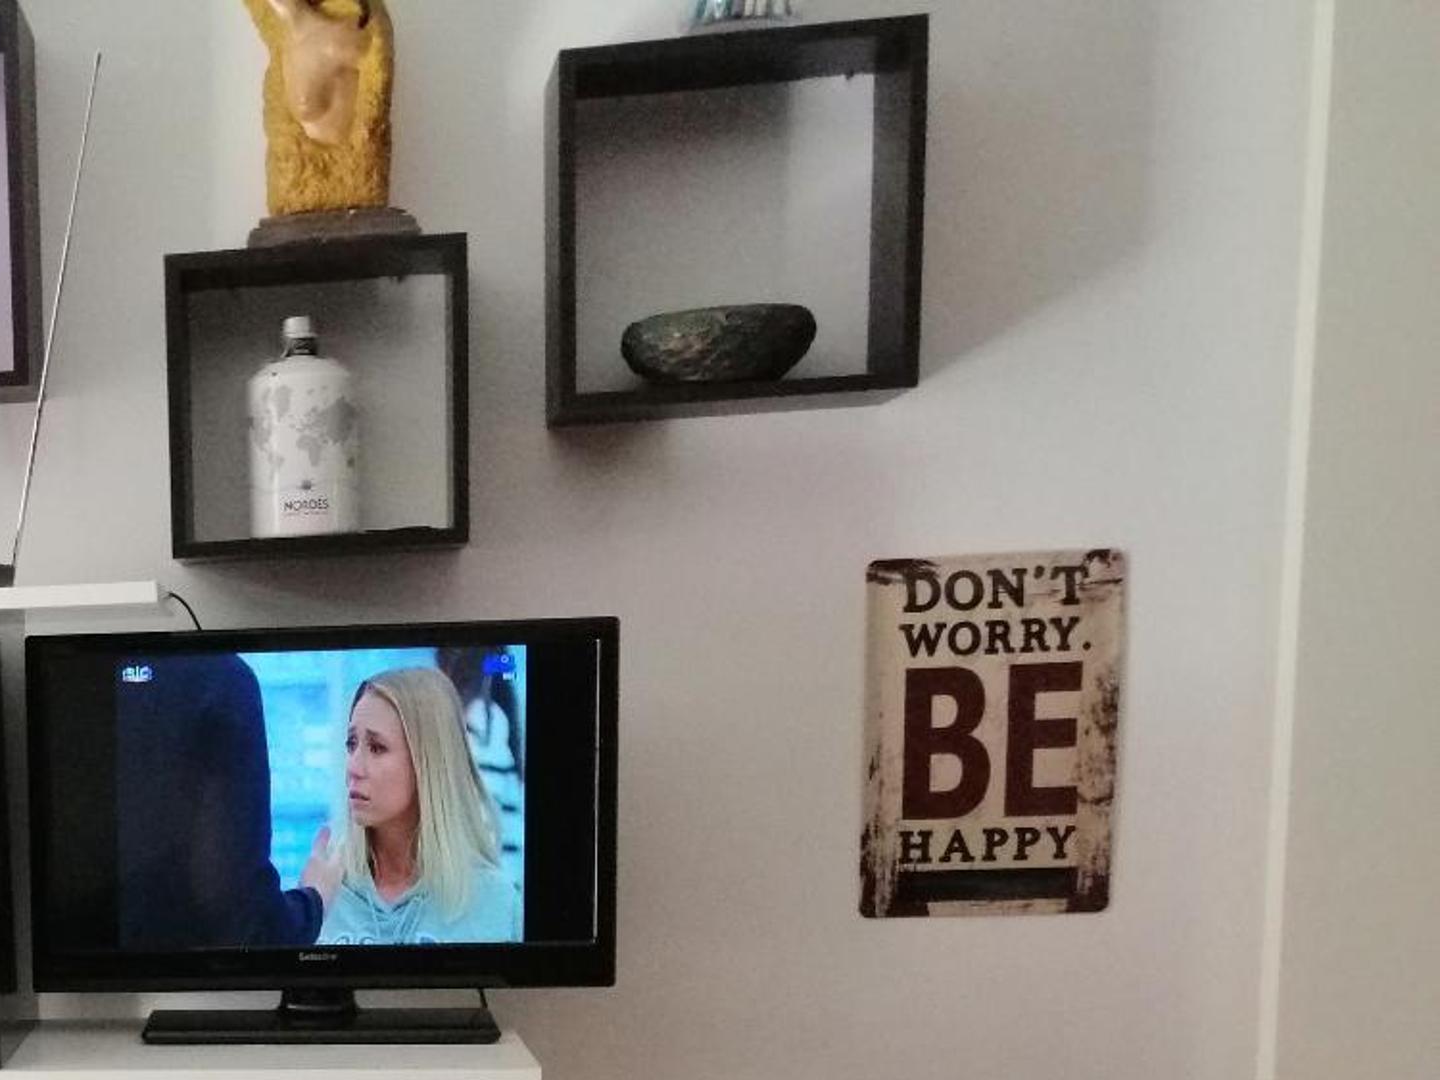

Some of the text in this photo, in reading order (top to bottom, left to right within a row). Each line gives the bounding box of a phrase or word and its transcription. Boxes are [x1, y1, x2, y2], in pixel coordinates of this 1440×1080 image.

[902, 564, 1087, 614] DON'T
[899, 616, 1092, 658] WORRY.
[902, 661, 1084, 820] BE
[898, 826, 1077, 865] HAPPY
